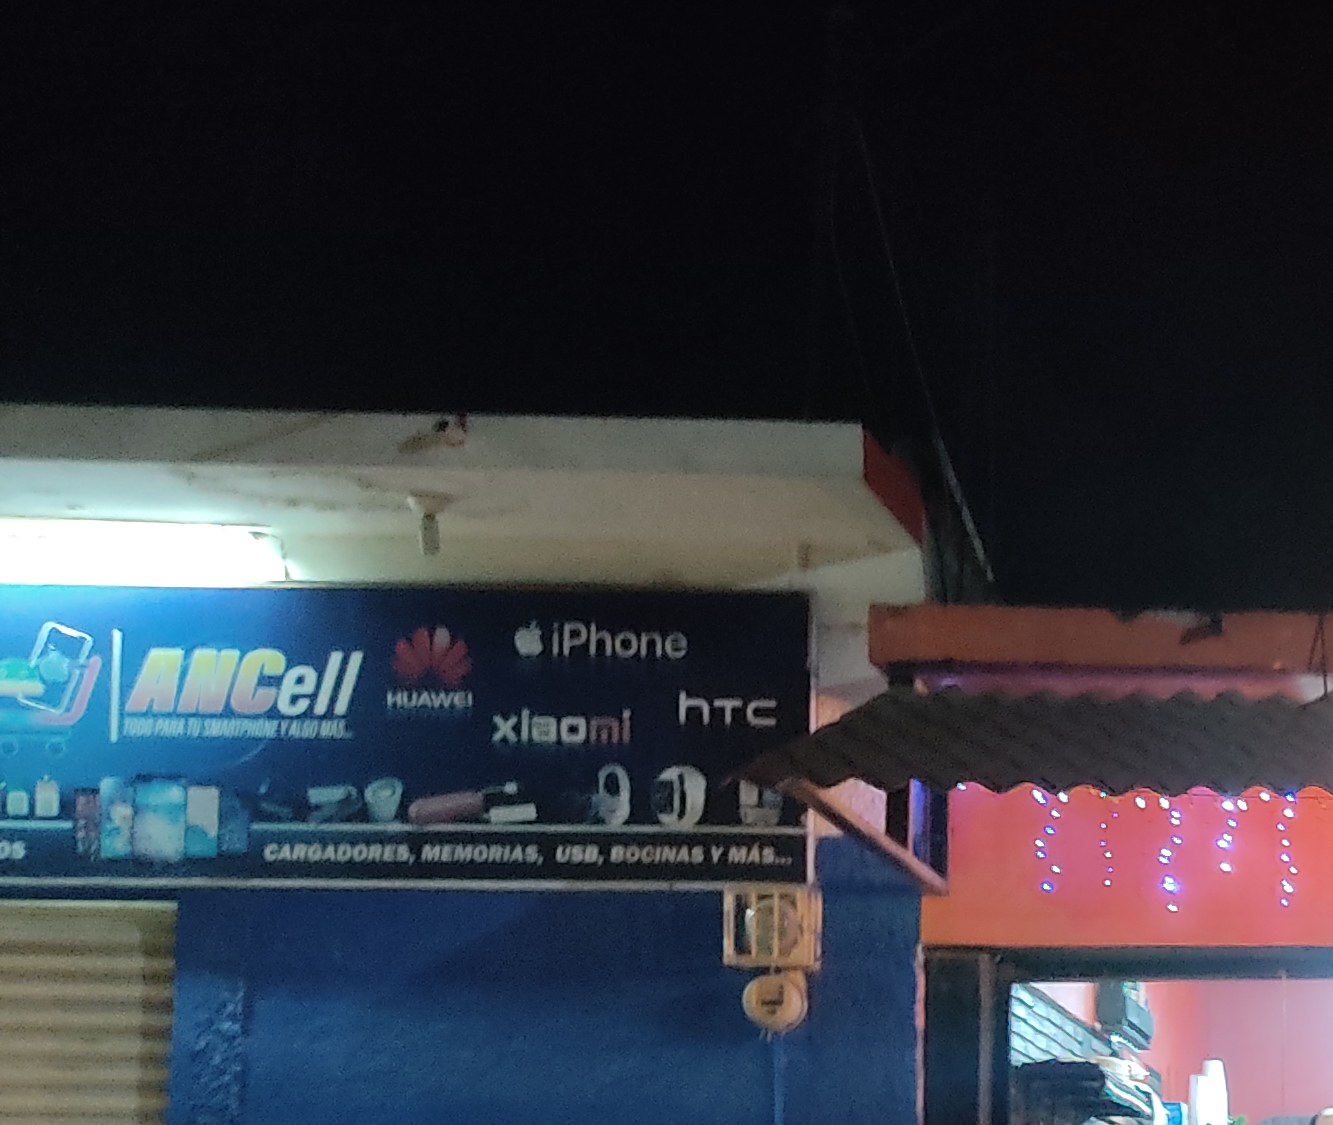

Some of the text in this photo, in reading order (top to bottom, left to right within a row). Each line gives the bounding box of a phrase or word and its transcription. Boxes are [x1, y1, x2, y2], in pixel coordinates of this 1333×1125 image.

[550, 622, 689, 660] iPhone
[124, 647, 364, 716] ANCell
[386, 690, 474, 710] HUAWEI
[154, 717, 183, 737] PARA
[491, 709, 632, 745] xiaomi
[263, 842, 416, 865] CARGADORES,
[421, 843, 543, 866] MEMORIAS,
[610, 845, 704, 865] BOCINAS
[710, 845, 724, 865] Y
